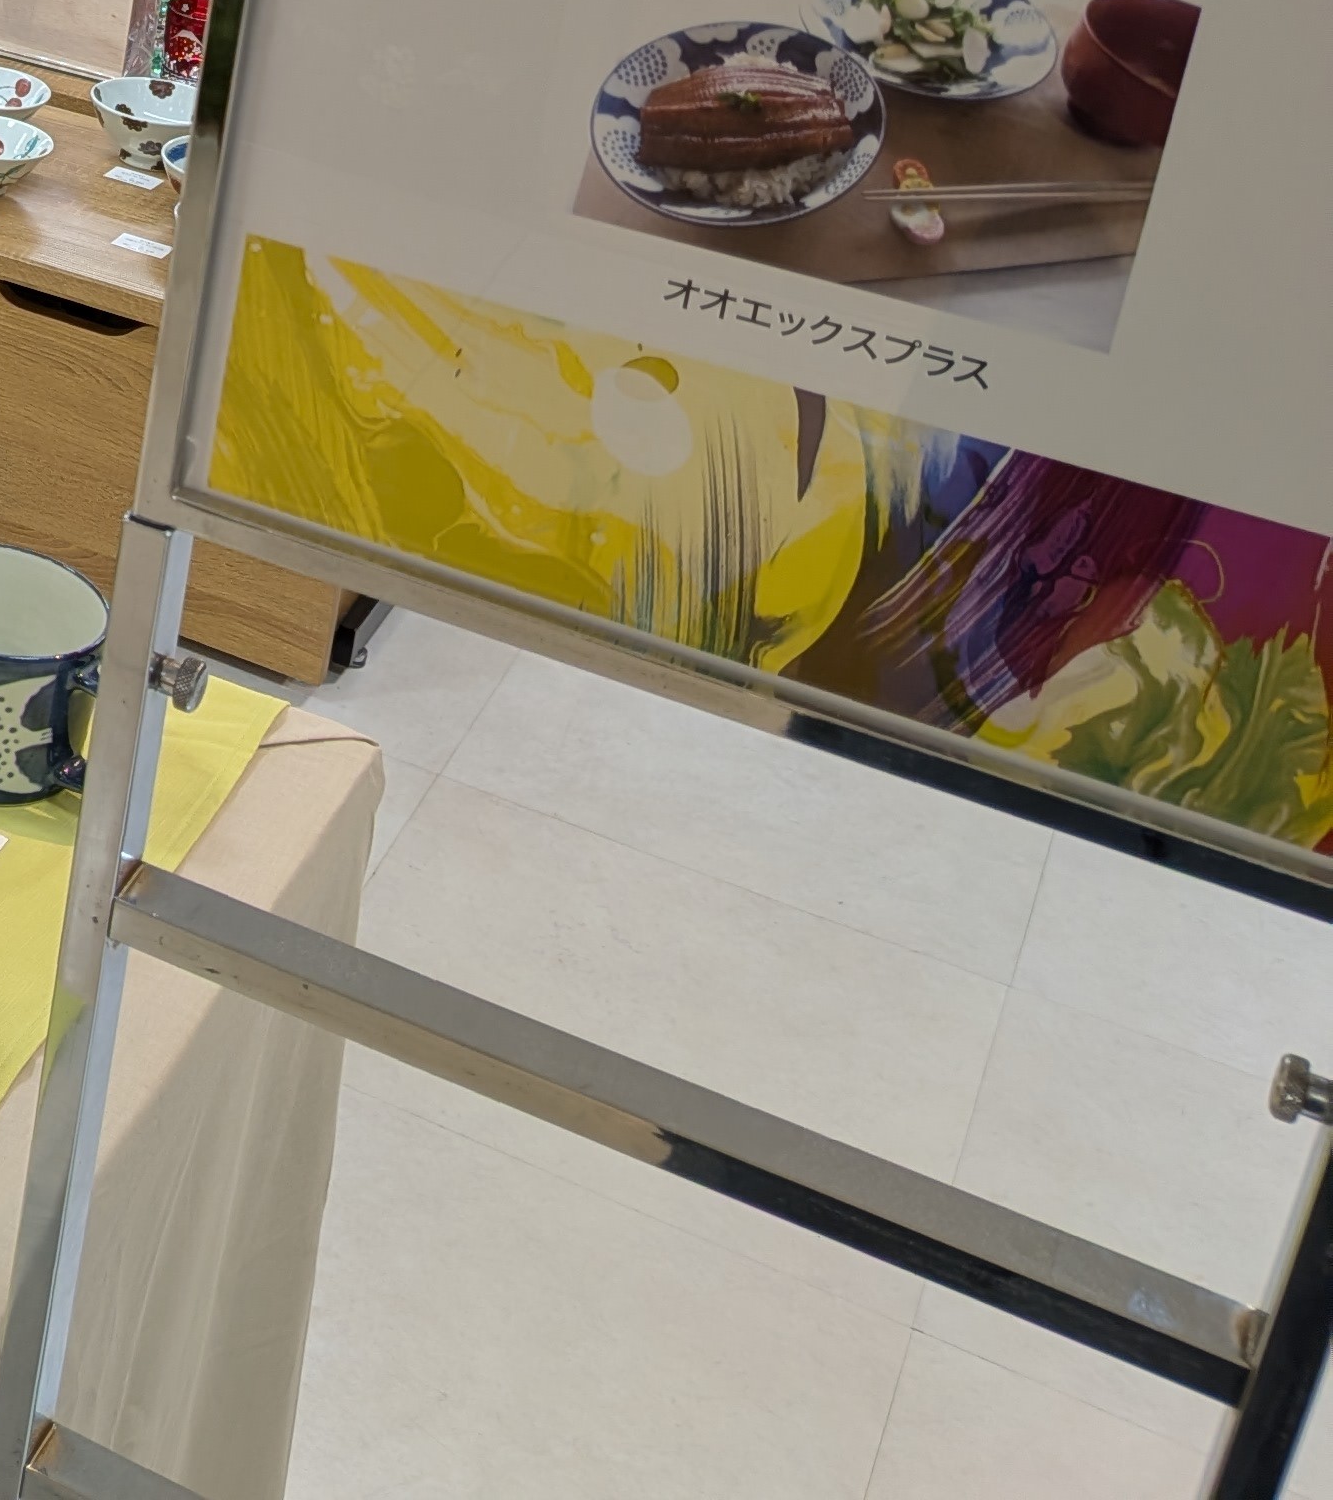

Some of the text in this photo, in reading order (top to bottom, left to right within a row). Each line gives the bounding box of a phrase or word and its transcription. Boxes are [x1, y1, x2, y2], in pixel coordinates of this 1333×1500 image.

[663, 279, 990, 390] オオエックスプラス
